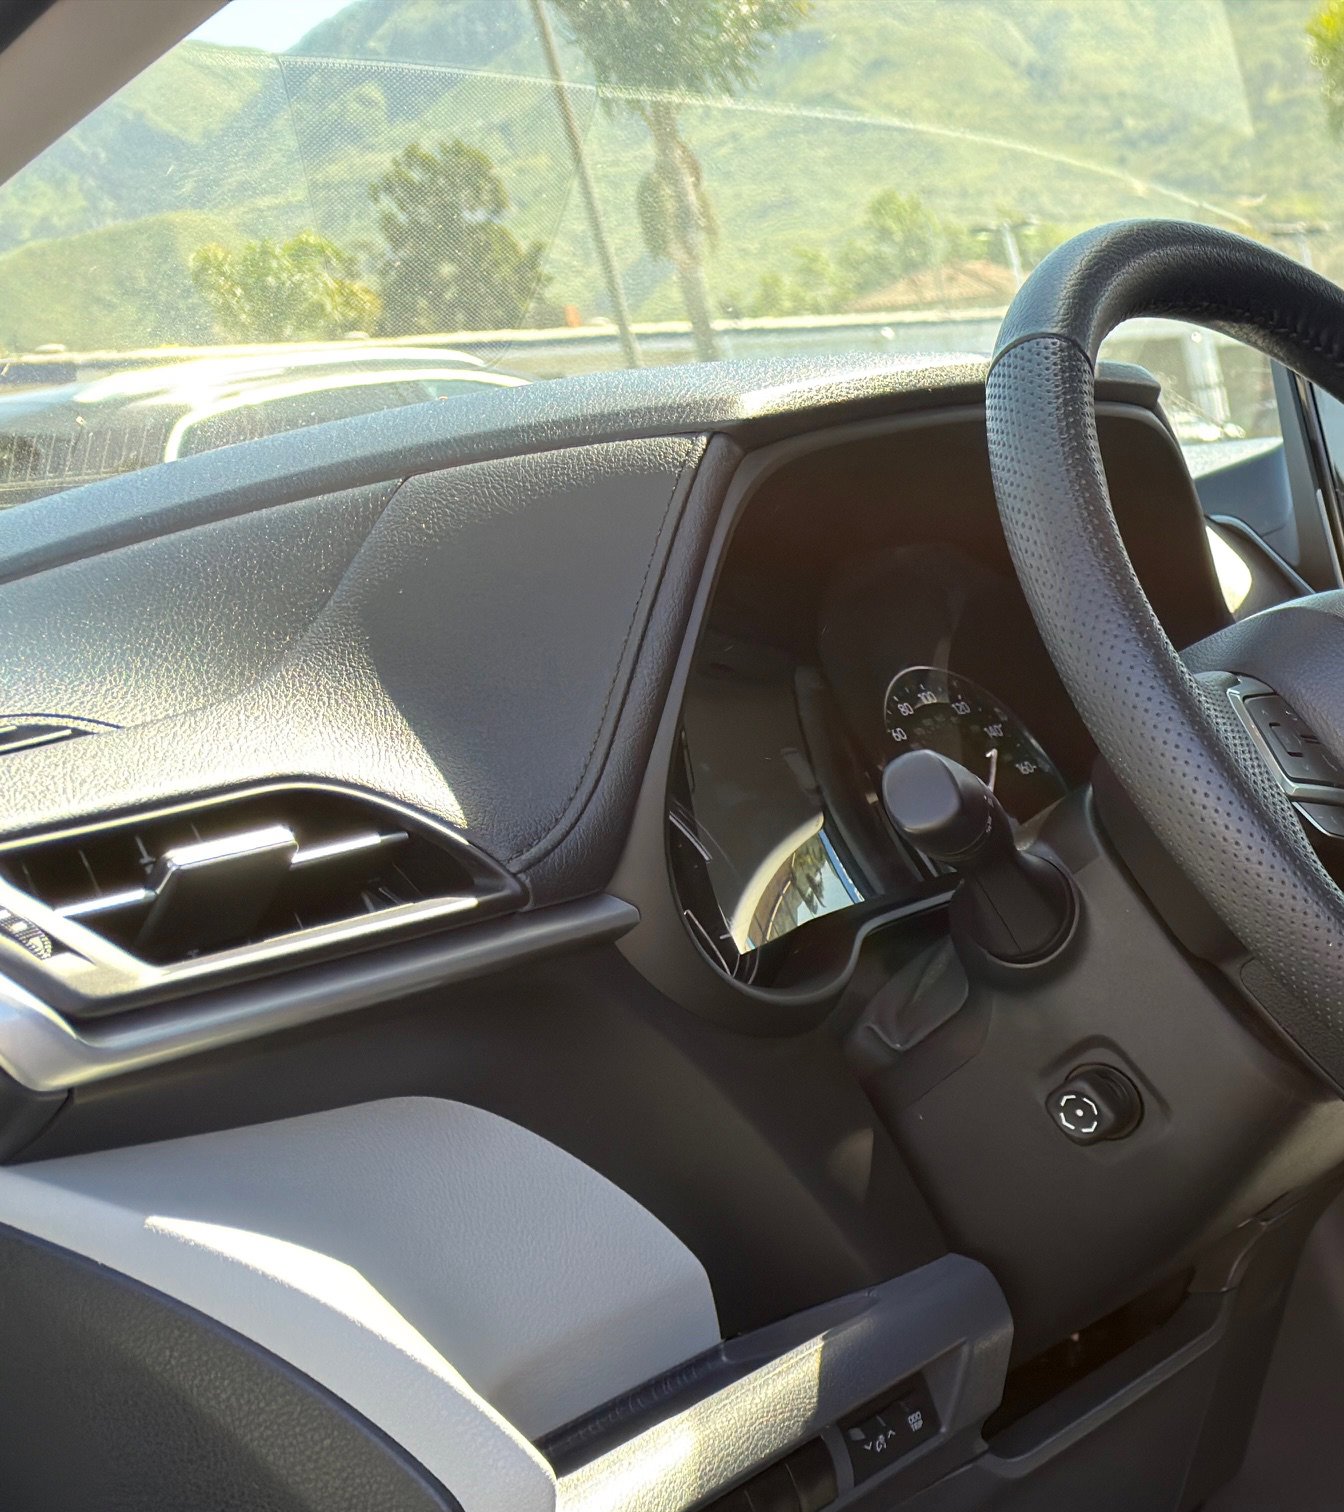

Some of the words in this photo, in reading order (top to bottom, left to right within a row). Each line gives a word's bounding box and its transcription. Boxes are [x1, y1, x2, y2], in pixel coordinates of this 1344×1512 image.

[917, 691, 938, 704] 100
[897, 702, 915, 716] 80
[951, 701, 971, 715] 120
[891, 727, 907, 742] 60
[983, 723, 1004, 738] 140
[1015, 761, 1034, 775] 160
